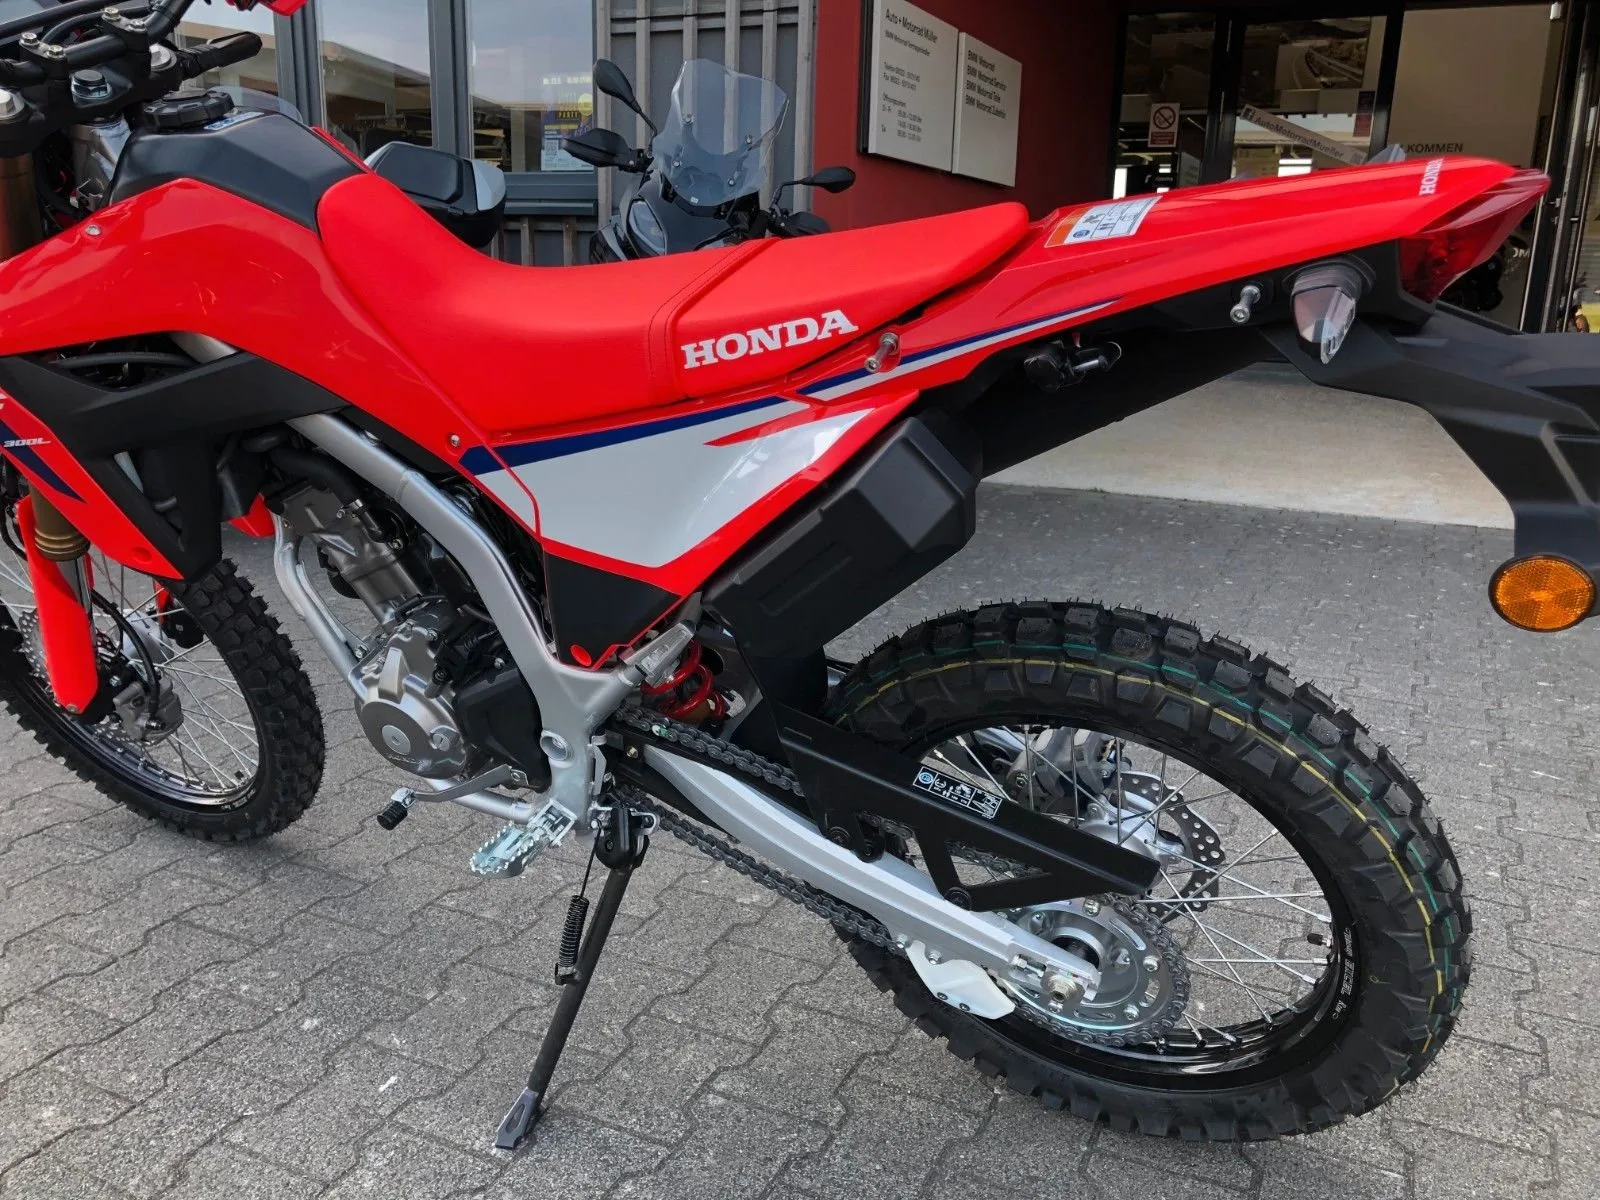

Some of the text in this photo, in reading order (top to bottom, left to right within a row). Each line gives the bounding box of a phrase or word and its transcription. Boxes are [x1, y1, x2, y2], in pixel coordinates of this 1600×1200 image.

[885, 8, 898, 24] Auto
[902, 16, 923, 37] Motorrad
[1404, 143, 1464, 153] KOMMEN
[1418, 158, 1444, 196] HONDA
[680, 309, 859, 370] HONDA
[3, 437, 52, 448] 300L
[1341, 958, 1355, 995] EXCEL
